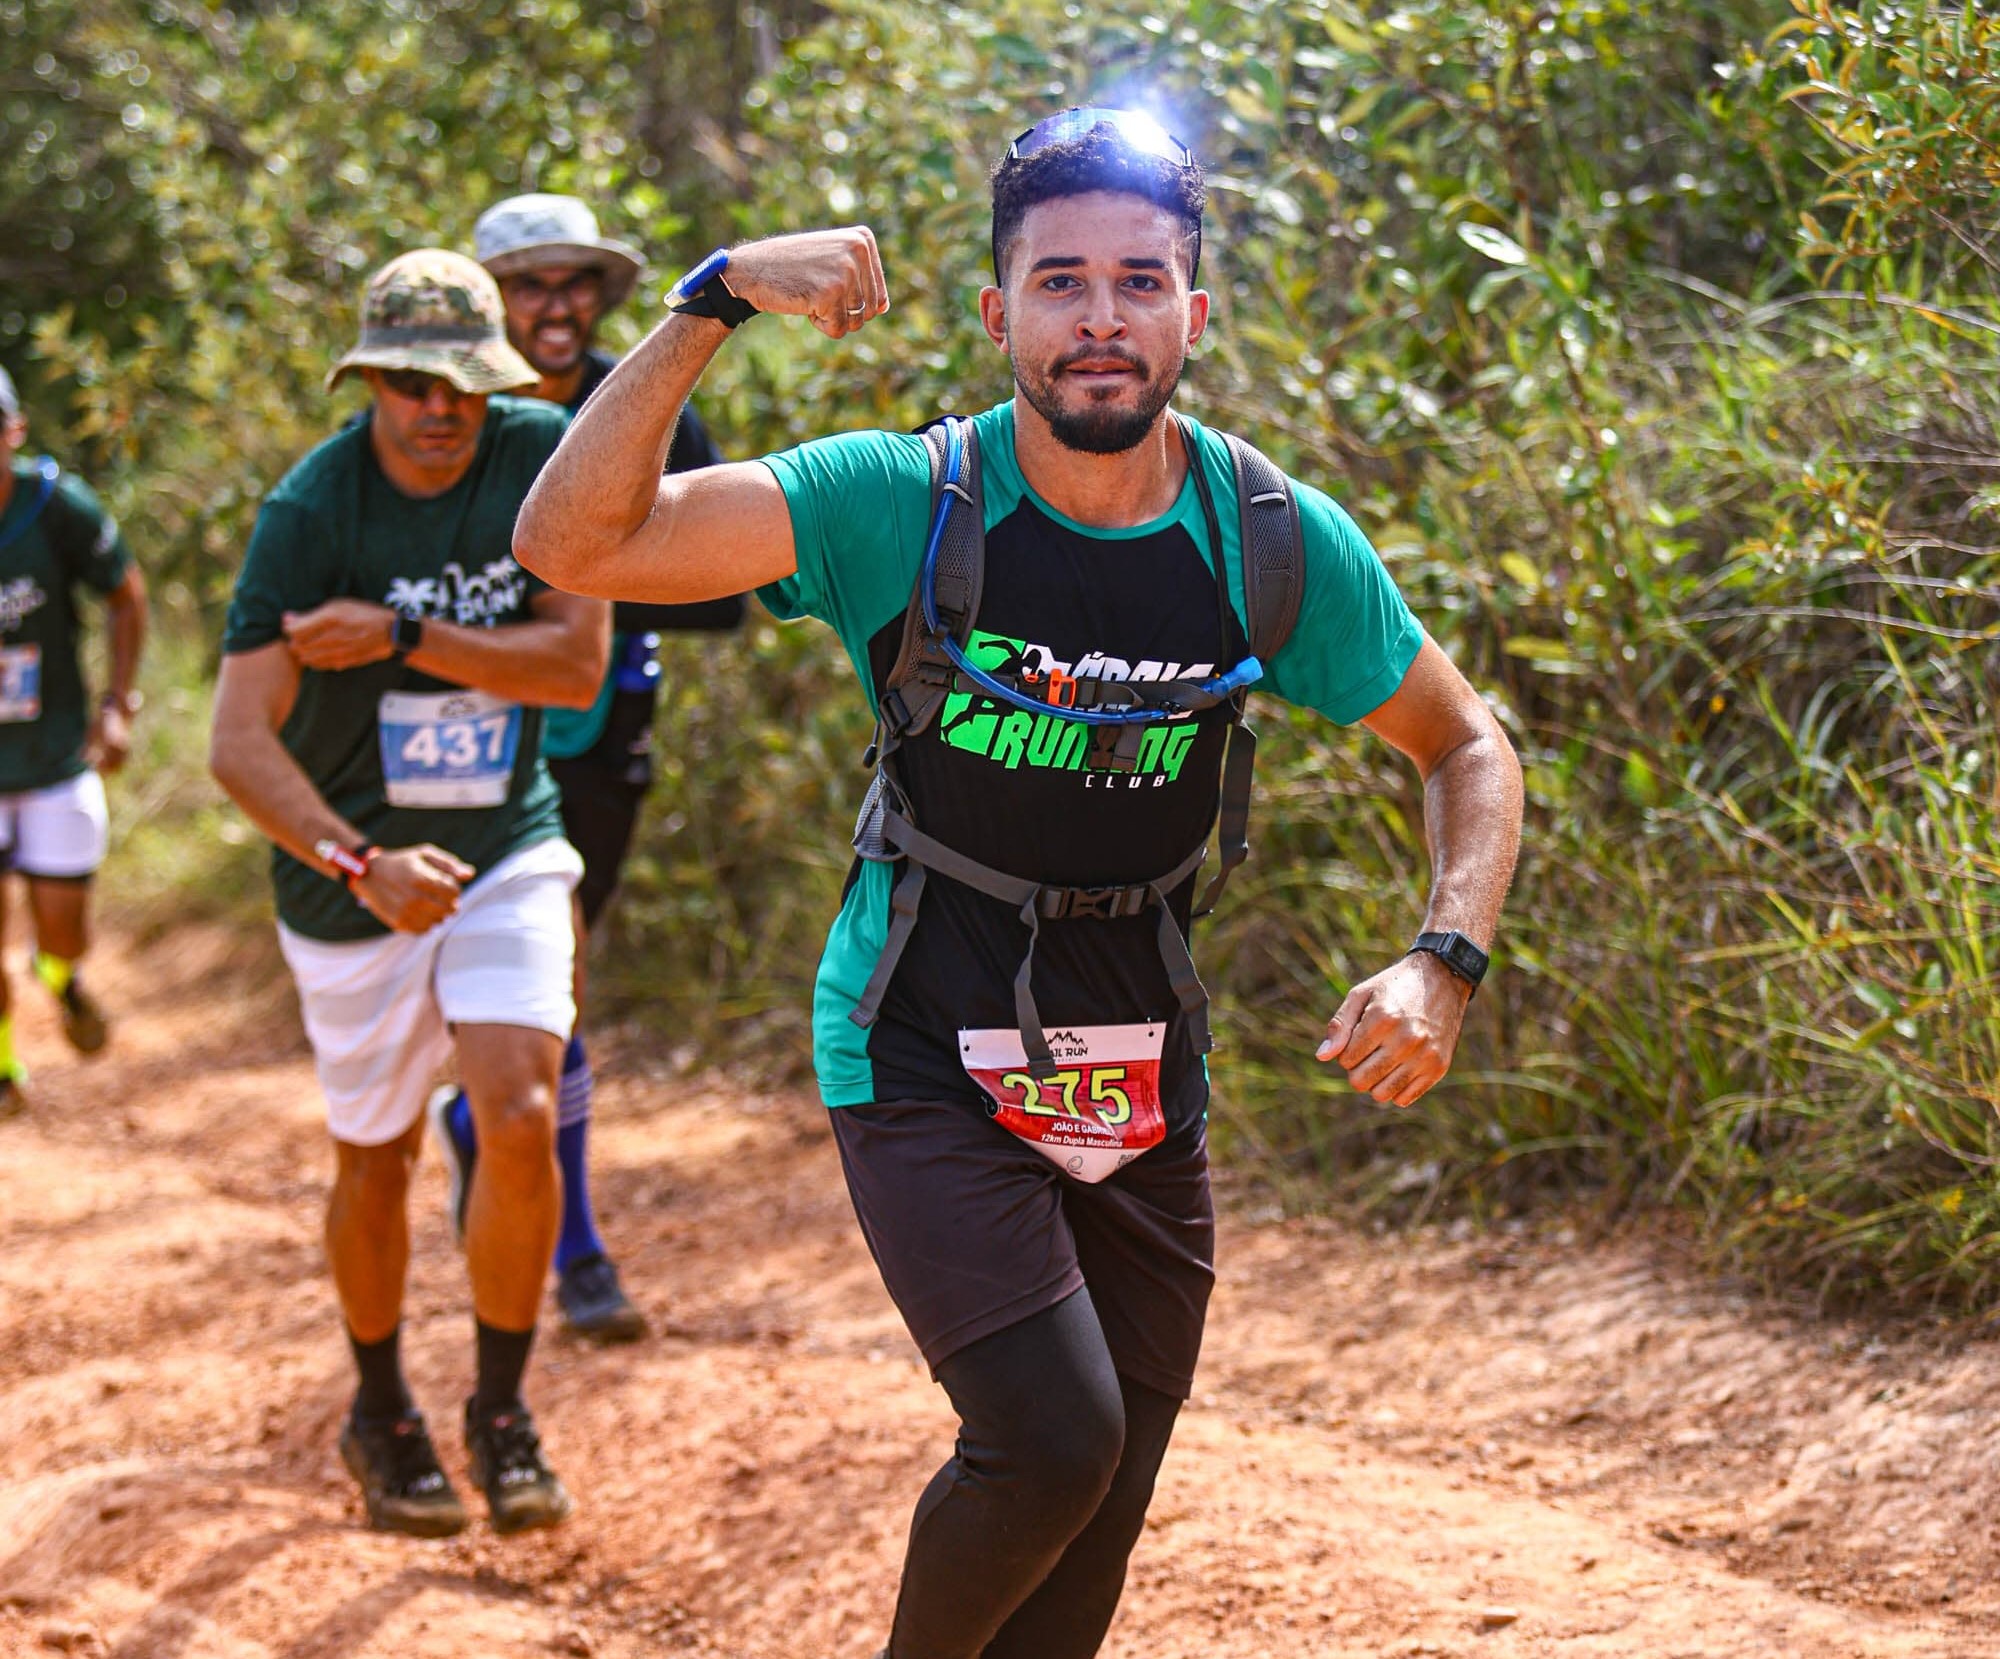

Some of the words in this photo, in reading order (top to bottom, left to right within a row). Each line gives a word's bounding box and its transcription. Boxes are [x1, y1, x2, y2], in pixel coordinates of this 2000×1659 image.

[402, 715, 508, 768] 437
[990, 711, 1199, 782] RUNNG
[1084, 774, 1166, 789] CLUB
[1065, 1047, 1088, 1056] RUN
[1001, 1066, 1132, 1125] 275
[1051, 1121, 1073, 1132] JOÃO
[1074, 1124, 1081, 1133] E
[1040, 1133, 1062, 1143] 12km
[1063, 1135, 1085, 1147] Dupla
[1086, 1137, 1122, 1148] Masculina
